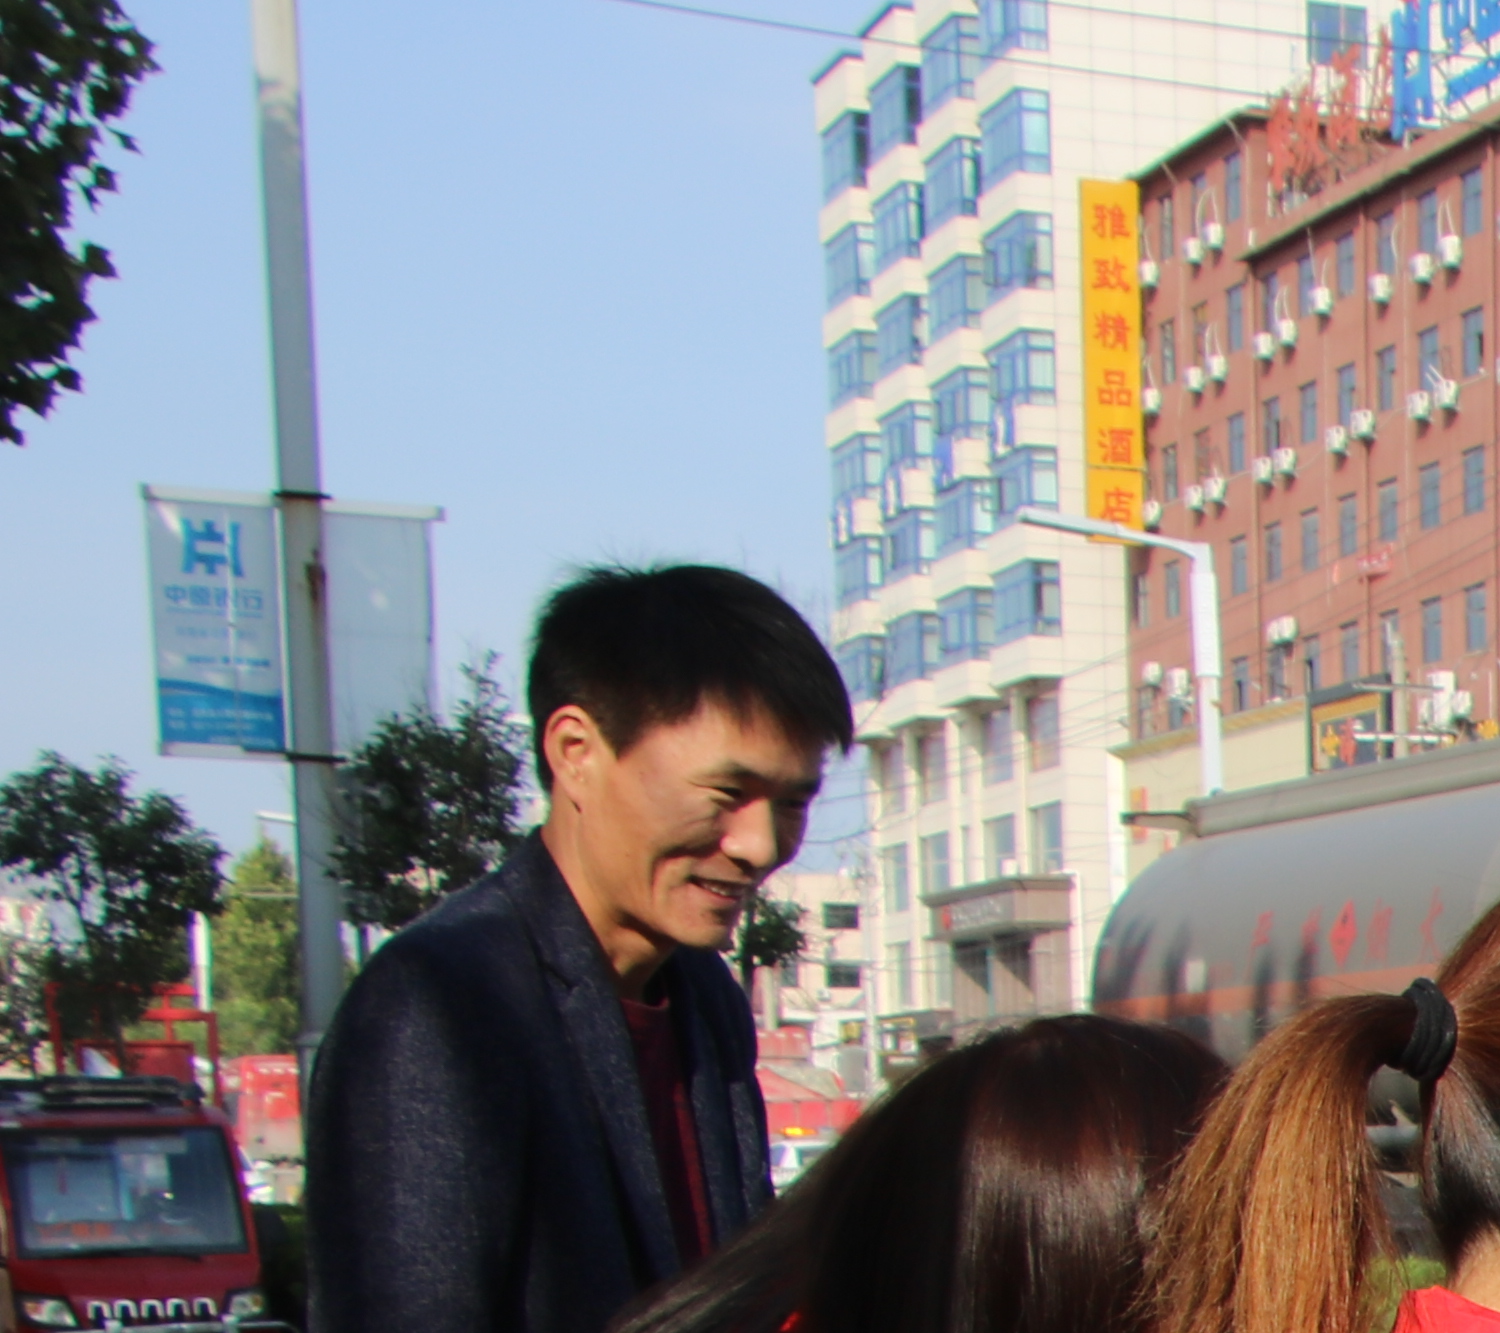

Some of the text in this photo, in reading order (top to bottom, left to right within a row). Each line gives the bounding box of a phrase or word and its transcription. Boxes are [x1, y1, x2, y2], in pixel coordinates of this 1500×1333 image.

[1091, 202, 1133, 524] 雅致精品酒店
